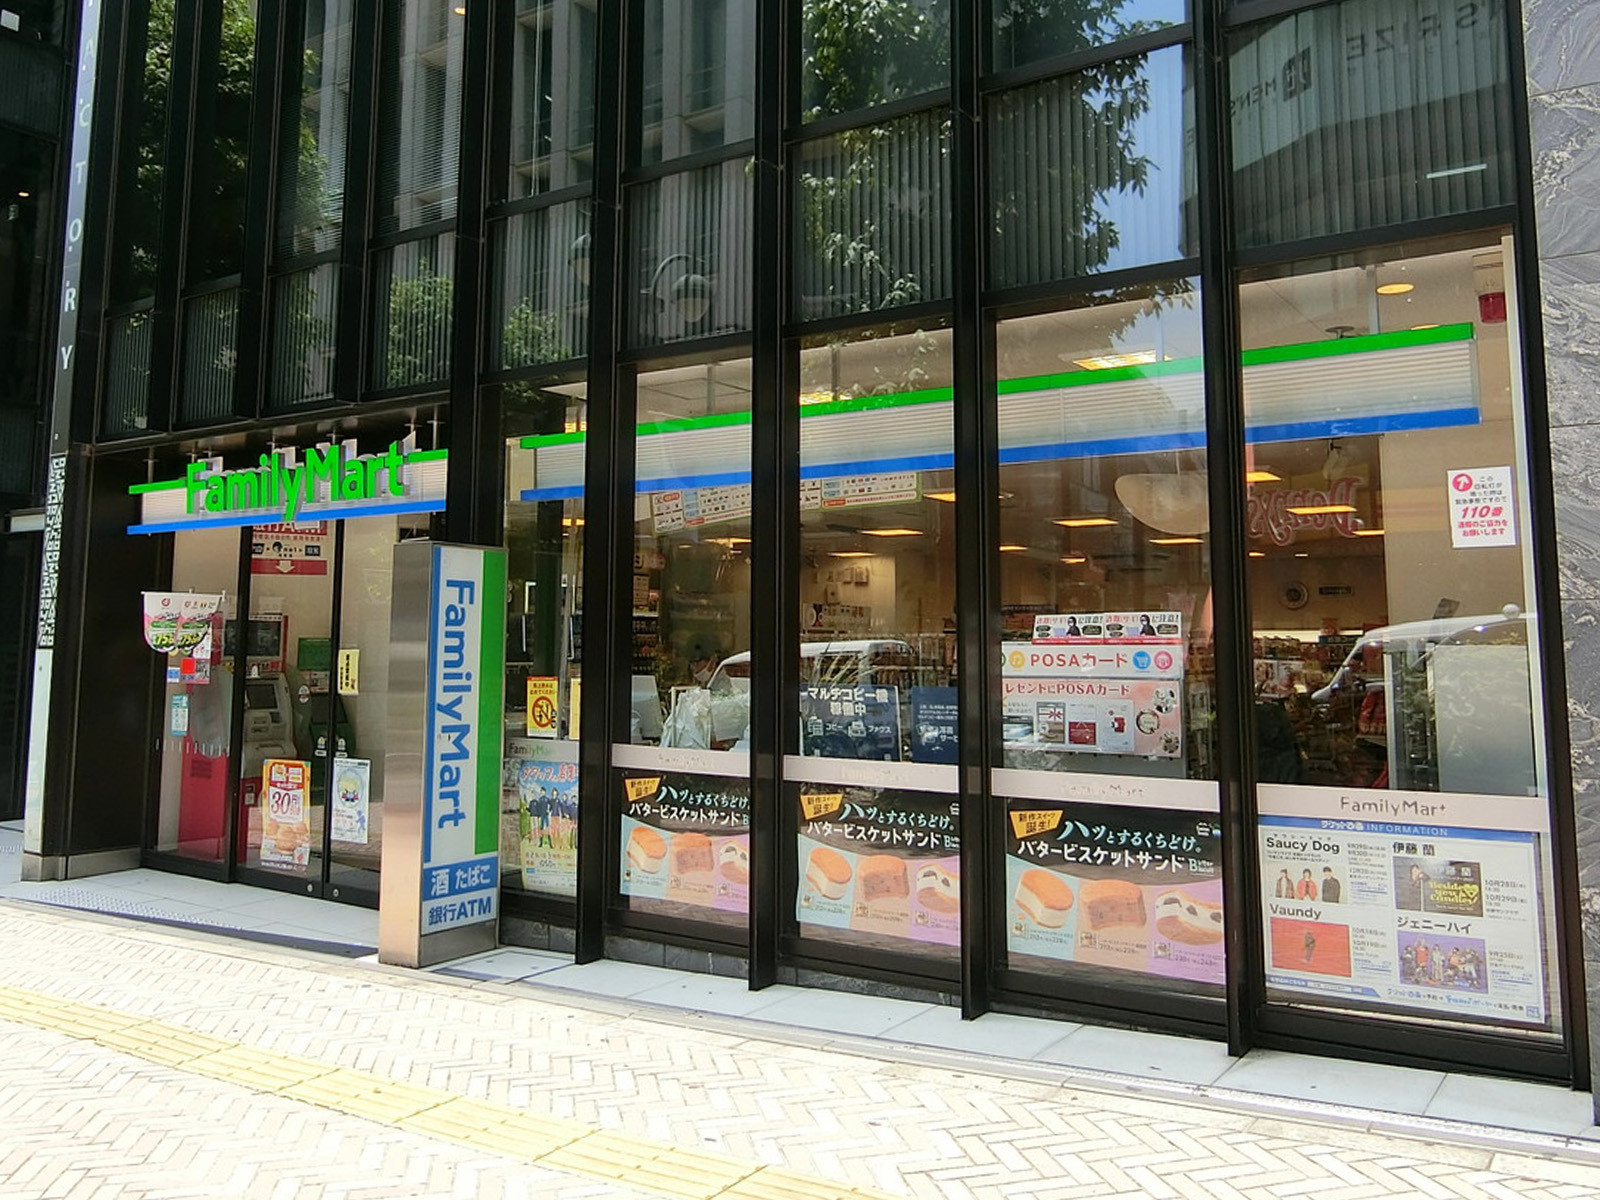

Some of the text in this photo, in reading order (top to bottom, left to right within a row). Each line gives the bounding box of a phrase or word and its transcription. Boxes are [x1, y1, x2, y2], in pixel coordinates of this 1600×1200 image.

[61, 0, 96, 370] ACTORY
[185, 440, 404, 522] FamilyMart
[1461, 505, 1503, 519] 110番
[1030, 652, 1129, 669] POSAカード
[436, 579, 475, 829] FamilyMart
[807, 687, 889, 703] マルチコピー機
[830, 701, 867, 717] 稼働中
[825, 722, 843, 732] コピー
[629, 802, 740, 827] バタービスケットサンド
[1340, 796, 1446, 817] FamilyMart
[838, 802, 955, 832] ハッとするくちどけ。
[1018, 812, 1057, 823] 新作スイーツ
[806, 820, 942, 850] バタービスケットサンド
[1025, 820, 1052, 835] 誕生!
[1056, 819, 1202, 854] ハッとするくちどけ。
[1366, 823, 1449, 837] INFORMATION
[1265, 836, 1341, 855] Saucy Dog
[1392, 841, 1418, 855] 伊藤
[1017, 840, 1186, 874] バタービスケットサンド
[430, 864, 491, 897] 酒 たばこ
[427, 895, 493, 927] 銀行ATM
[1269, 903, 1322, 921] Vaundy
[1396, 916, 1472, 935] ジェニーハイ
